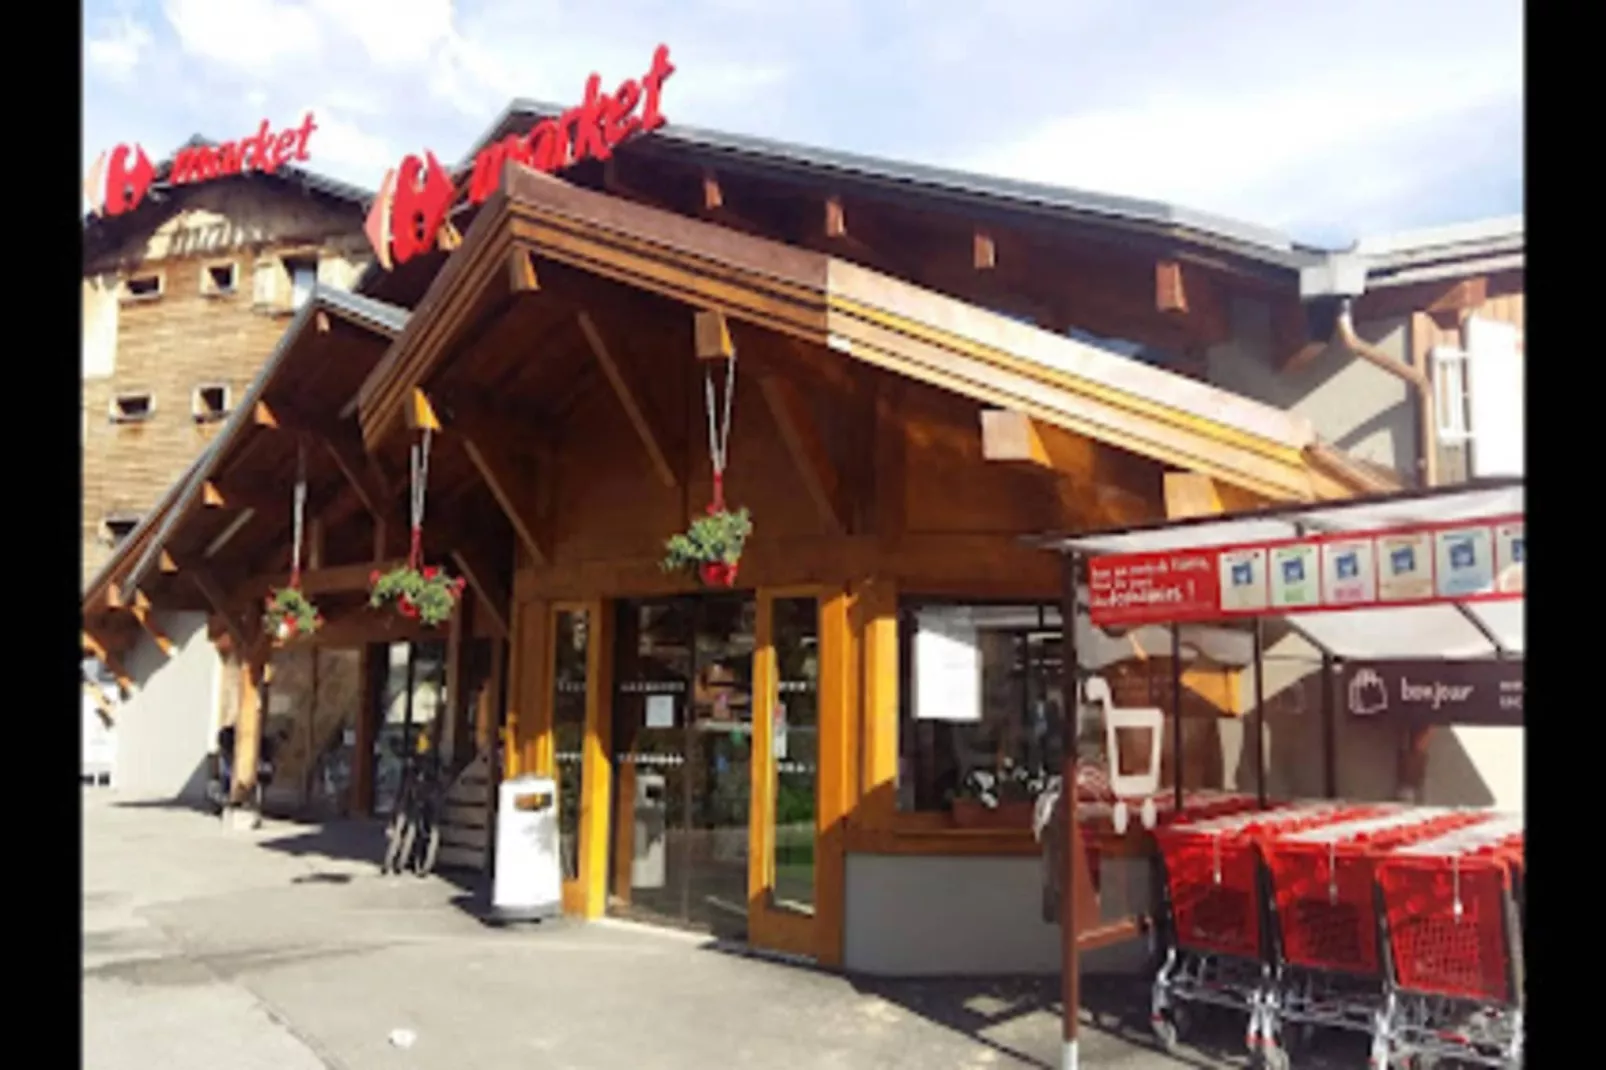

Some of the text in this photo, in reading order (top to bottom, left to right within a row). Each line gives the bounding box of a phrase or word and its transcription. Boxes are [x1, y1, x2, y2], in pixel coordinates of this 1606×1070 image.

[168, 111, 318, 186] market
[467, 43, 676, 205] market
[1400, 676, 1475, 711] bonjour
